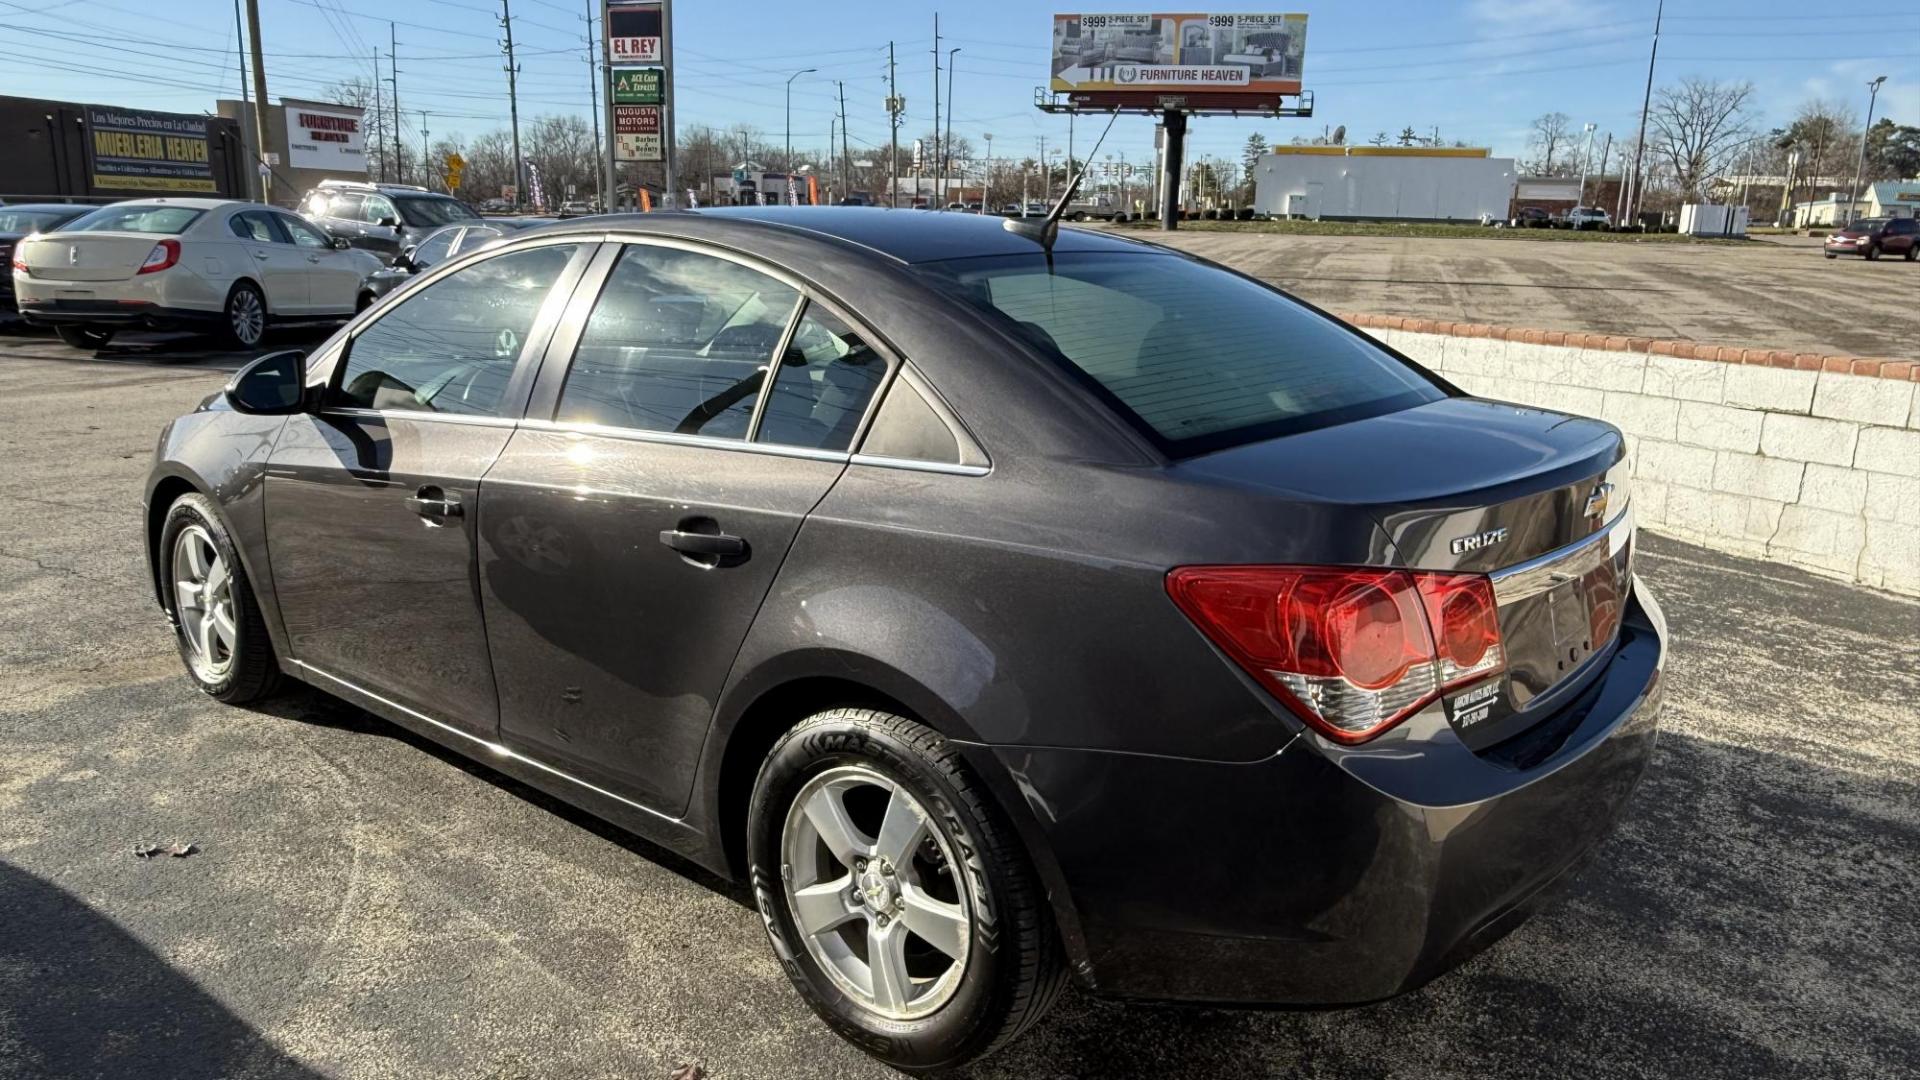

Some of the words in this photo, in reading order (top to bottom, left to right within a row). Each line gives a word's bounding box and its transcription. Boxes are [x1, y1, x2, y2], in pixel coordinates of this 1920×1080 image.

[1082, 16, 1106, 27] $999
[1136, 15, 1149, 23] SET
[1209, 16, 1234, 27] $999
[1268, 15, 1282, 23] SET
[614, 39, 628, 54] EL
[631, 38, 656, 54] REY
[1140, 69, 1198, 81] FURNITURE
[1201, 69, 1244, 81] HEAVEN
[92, 111, 106, 123] Los
[106, 113, 135, 127] Mejores
[137, 116, 163, 128] Precios
[163, 121, 172, 129] en
[173, 120, 181, 130] La
[182, 120, 206, 131] Ciudad
[299, 113, 359, 133] FURNITURE
[94, 131, 164, 159] MUEBLERIA
[166, 137, 209, 162] HEAVEN
[1451, 527, 1508, 555] CRUZE
